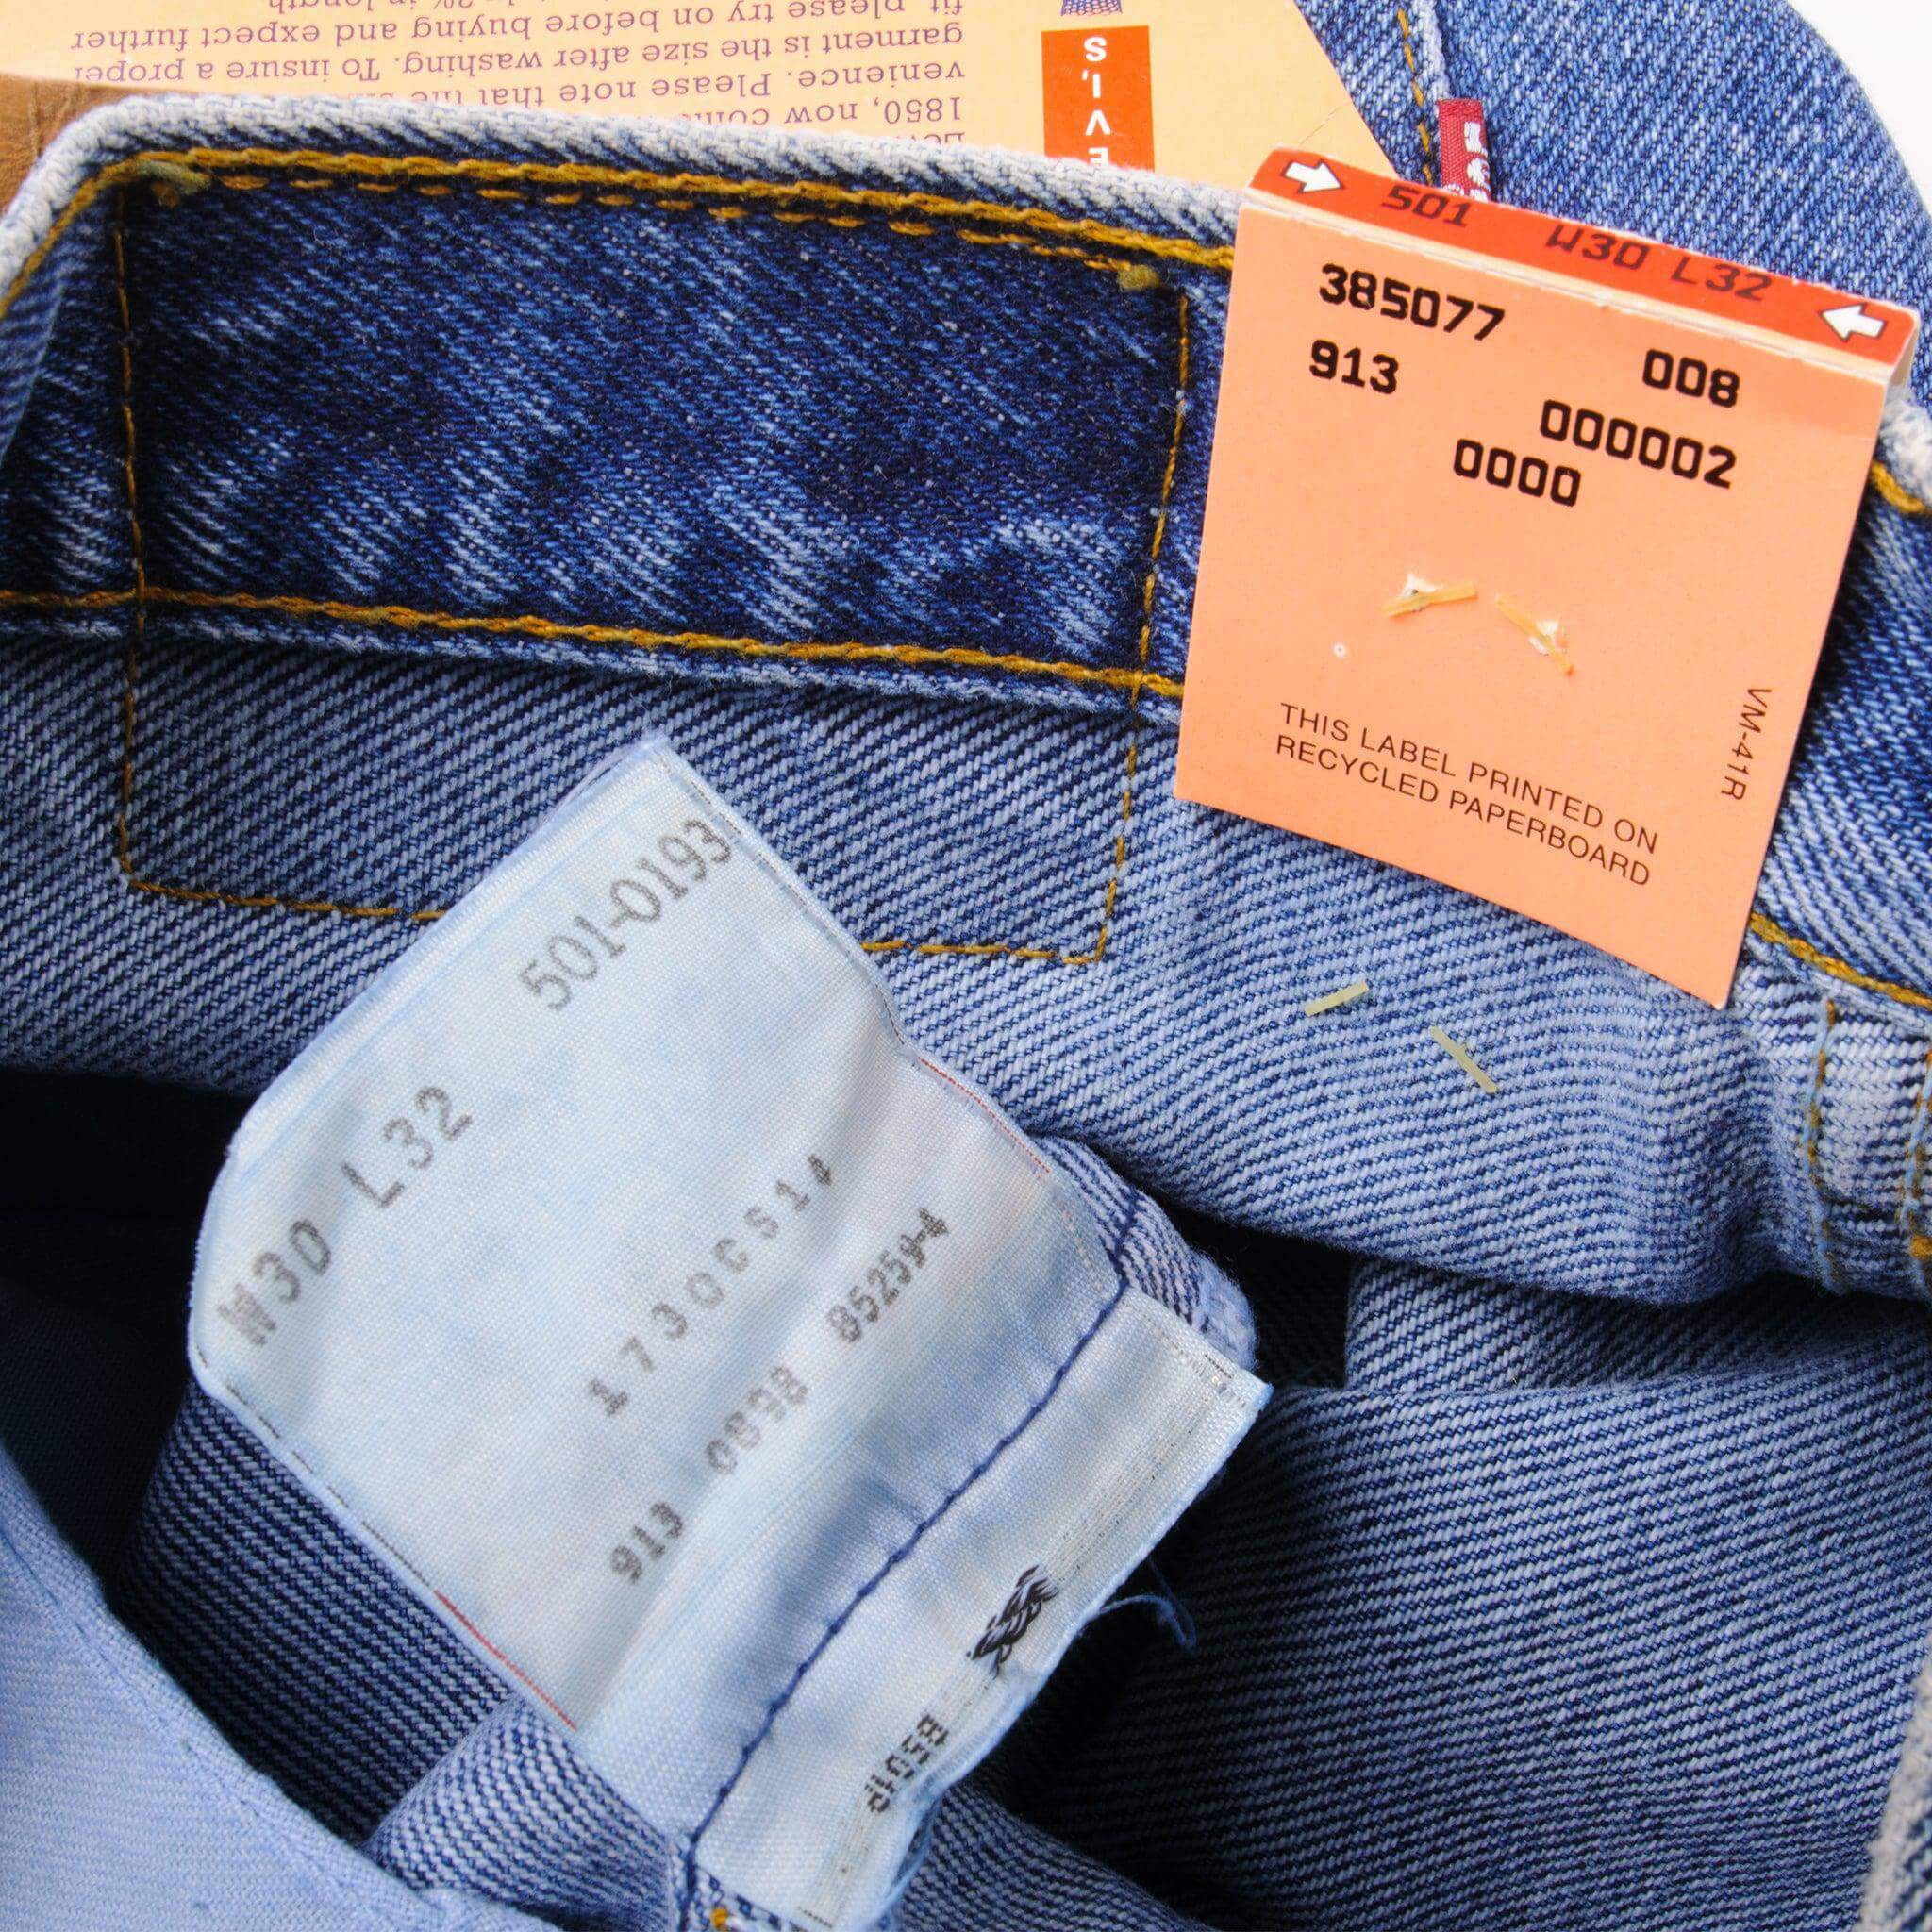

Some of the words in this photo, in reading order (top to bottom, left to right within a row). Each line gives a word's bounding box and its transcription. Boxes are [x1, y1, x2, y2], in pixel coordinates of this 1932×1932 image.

[545, 9, 659, 35] before
[672, 7, 715, 25] on
[727, 0, 774, 23] try
[788, 0, 906, 19] please
[70, 28, 189, 52] further
[200, 21, 320, 47] expect
[335, 22, 398, 47] and
[412, 14, 532, 42] buying
[823, 22, 964, 54] garment
[554, 46, 631, 71] after
[641, 42, 708, 66] size
[721, 38, 773, 61] the
[784, 36, 811, 58] is
[74, 58, 186, 83] proper
[195, 62, 215, 79] a
[225, 58, 331, 83] insure
[341, 58, 381, 81] To
[394, 51, 543, 78] washing.
[788, 61, 966, 88] venience.
[559, 81, 636, 103] note
[651, 73, 772, 96] Please
[785, 102, 858, 124] now
[874, 96, 961, 125] 1850,
[1082, 36, 1113, 166] EVI'S
[1381, 185, 1470, 227] 501
[1545, 225, 1651, 271] W30
[1670, 256, 1773, 302] L32
[1320, 263, 1505, 341] 385077
[1309, 339, 1399, 394] 913
[1642, 348, 1740, 408] 008
[1540, 399, 1737, 489] 000002
[1453, 439, 1581, 507] 0000
[1720, 688, 1773, 802] VM-41R
[1280, 702, 1349, 742] THIS
[1360, 727, 1456, 776] LABEL
[1469, 761, 1603, 829] PRINTED
[1614, 818, 1658, 855] ON
[1276, 734, 1438, 803] RECYCLED
[1448, 791, 1650, 886] PAPERBOARD
[216, 1218, 333, 1346] W30
[341, 1085, 474, 1208] L32
[520, 818, 733, 1011] 501-0193
[609, 1501, 684, 1584] 913
